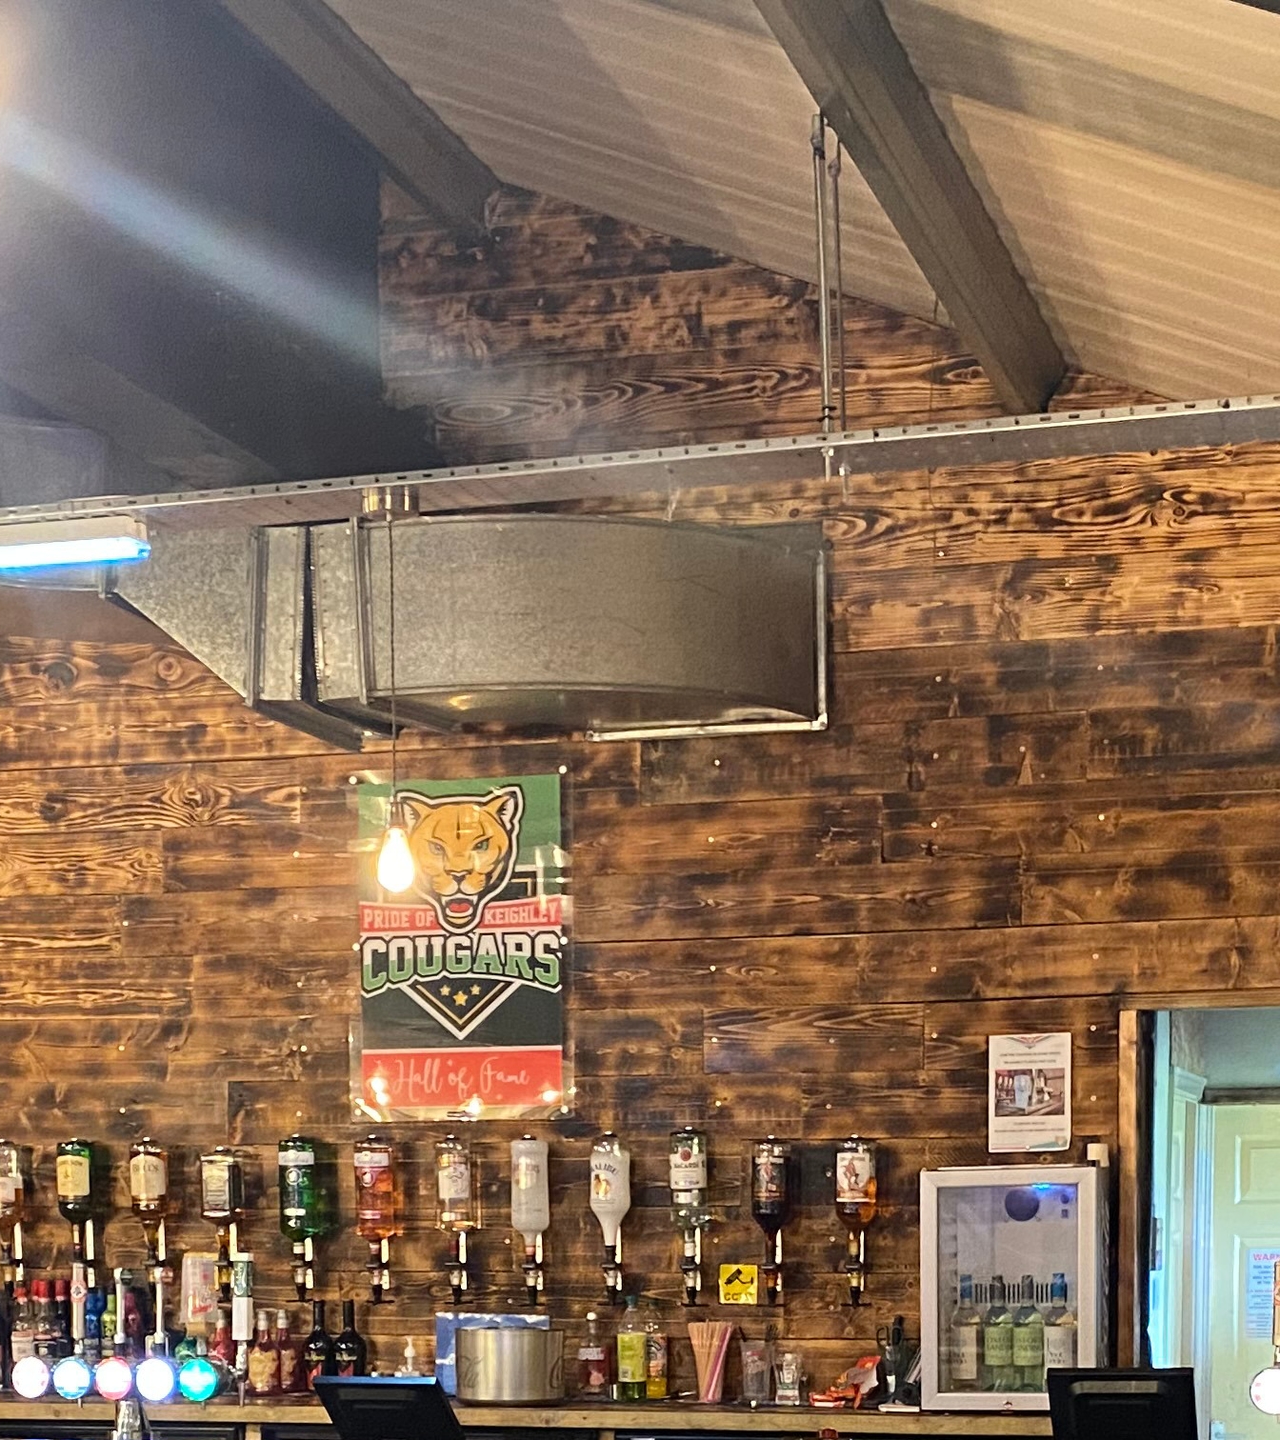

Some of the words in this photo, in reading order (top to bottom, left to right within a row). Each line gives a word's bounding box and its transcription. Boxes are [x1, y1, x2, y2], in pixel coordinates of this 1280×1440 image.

[363, 908, 409, 928] PRIDE
[415, 910, 435, 927] OF
[484, 900, 557, 925] KEIGHLEY
[362, 932, 560, 991] COUGARS
[393, 1057, 443, 1103] Hall
[447, 1066, 473, 1101] of
[479, 1056, 531, 1095] Fame
